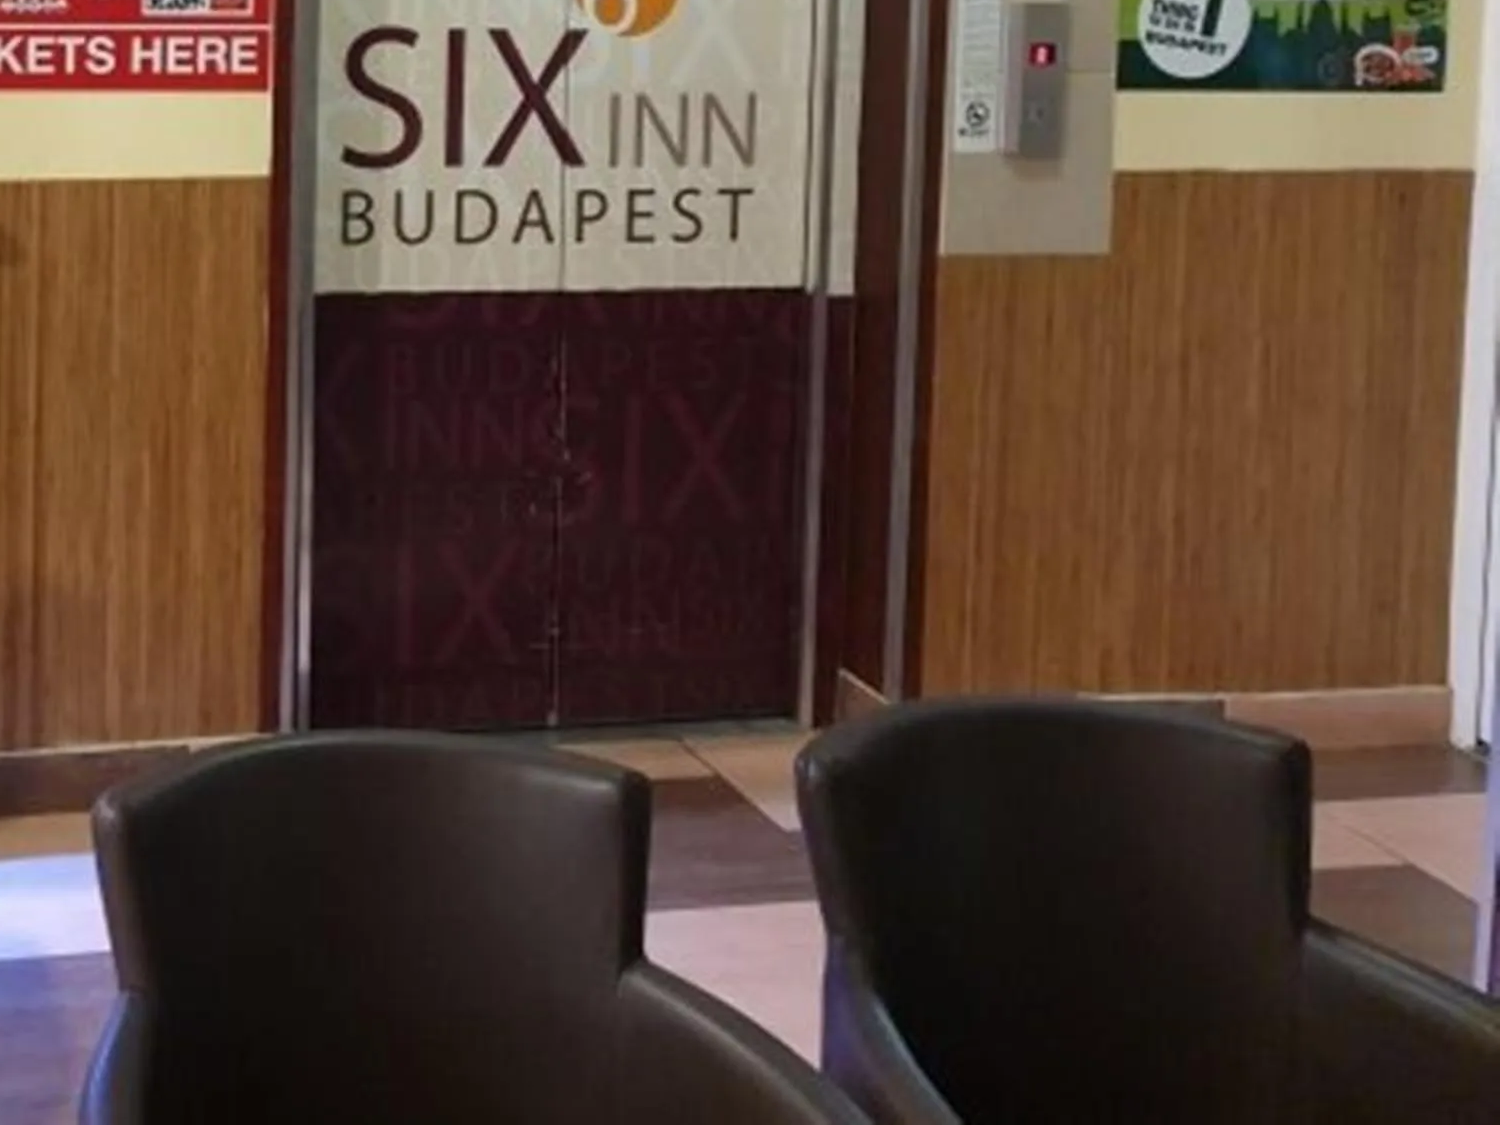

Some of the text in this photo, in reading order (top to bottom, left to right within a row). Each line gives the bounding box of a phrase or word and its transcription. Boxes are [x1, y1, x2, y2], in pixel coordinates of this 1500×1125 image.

[130, 36, 259, 74] HERE
[340, 25, 758, 170] SIX INN
[340, 188, 754, 246] BUDAPEST
